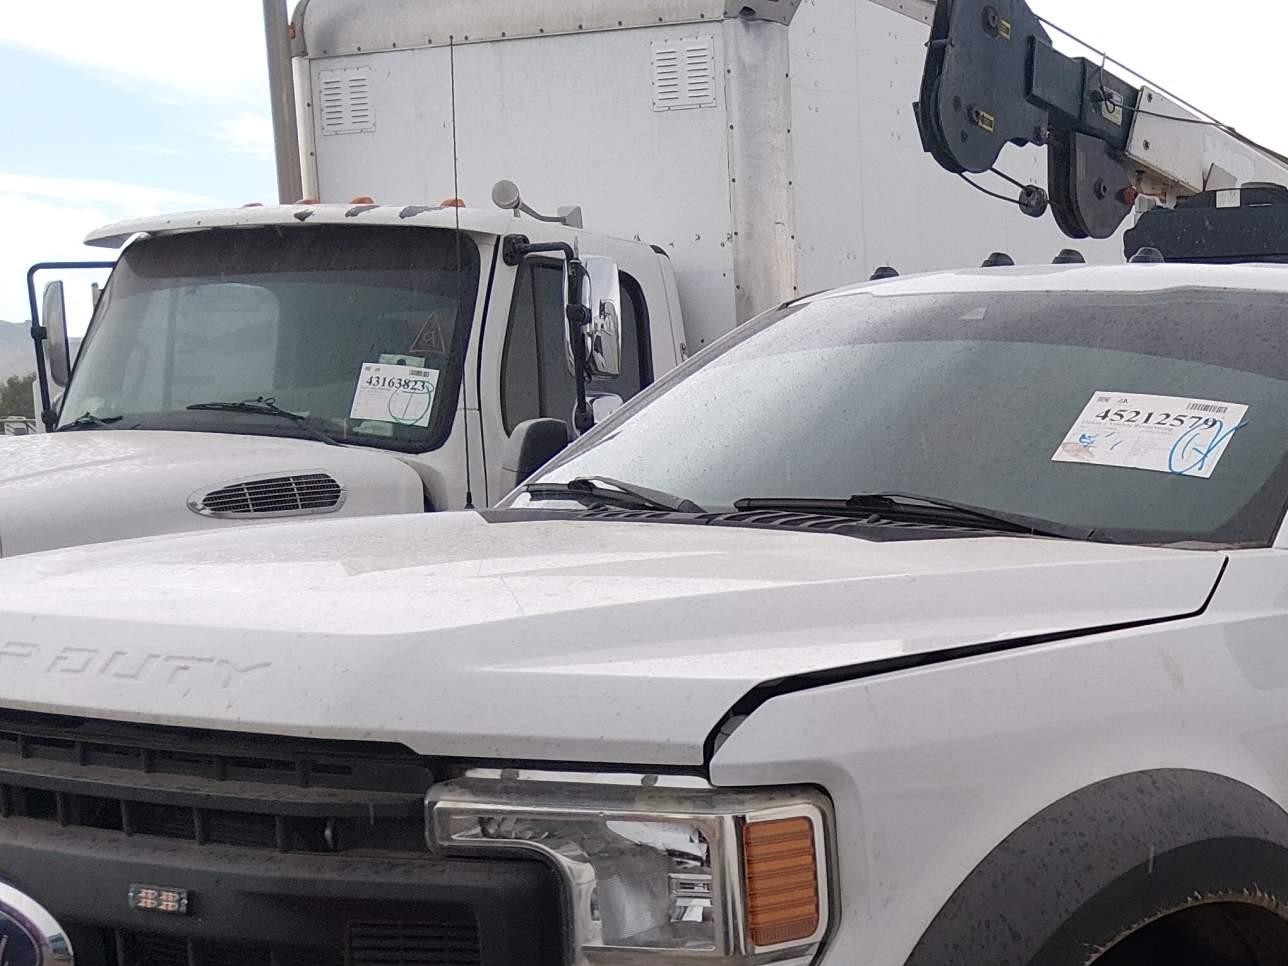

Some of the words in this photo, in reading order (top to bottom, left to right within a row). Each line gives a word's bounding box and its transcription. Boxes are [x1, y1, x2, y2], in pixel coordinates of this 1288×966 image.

[365, 375, 425, 392] 43163823
[1095, 407, 1218, 430] 45212579
[46, 645, 273, 689] DUTY
